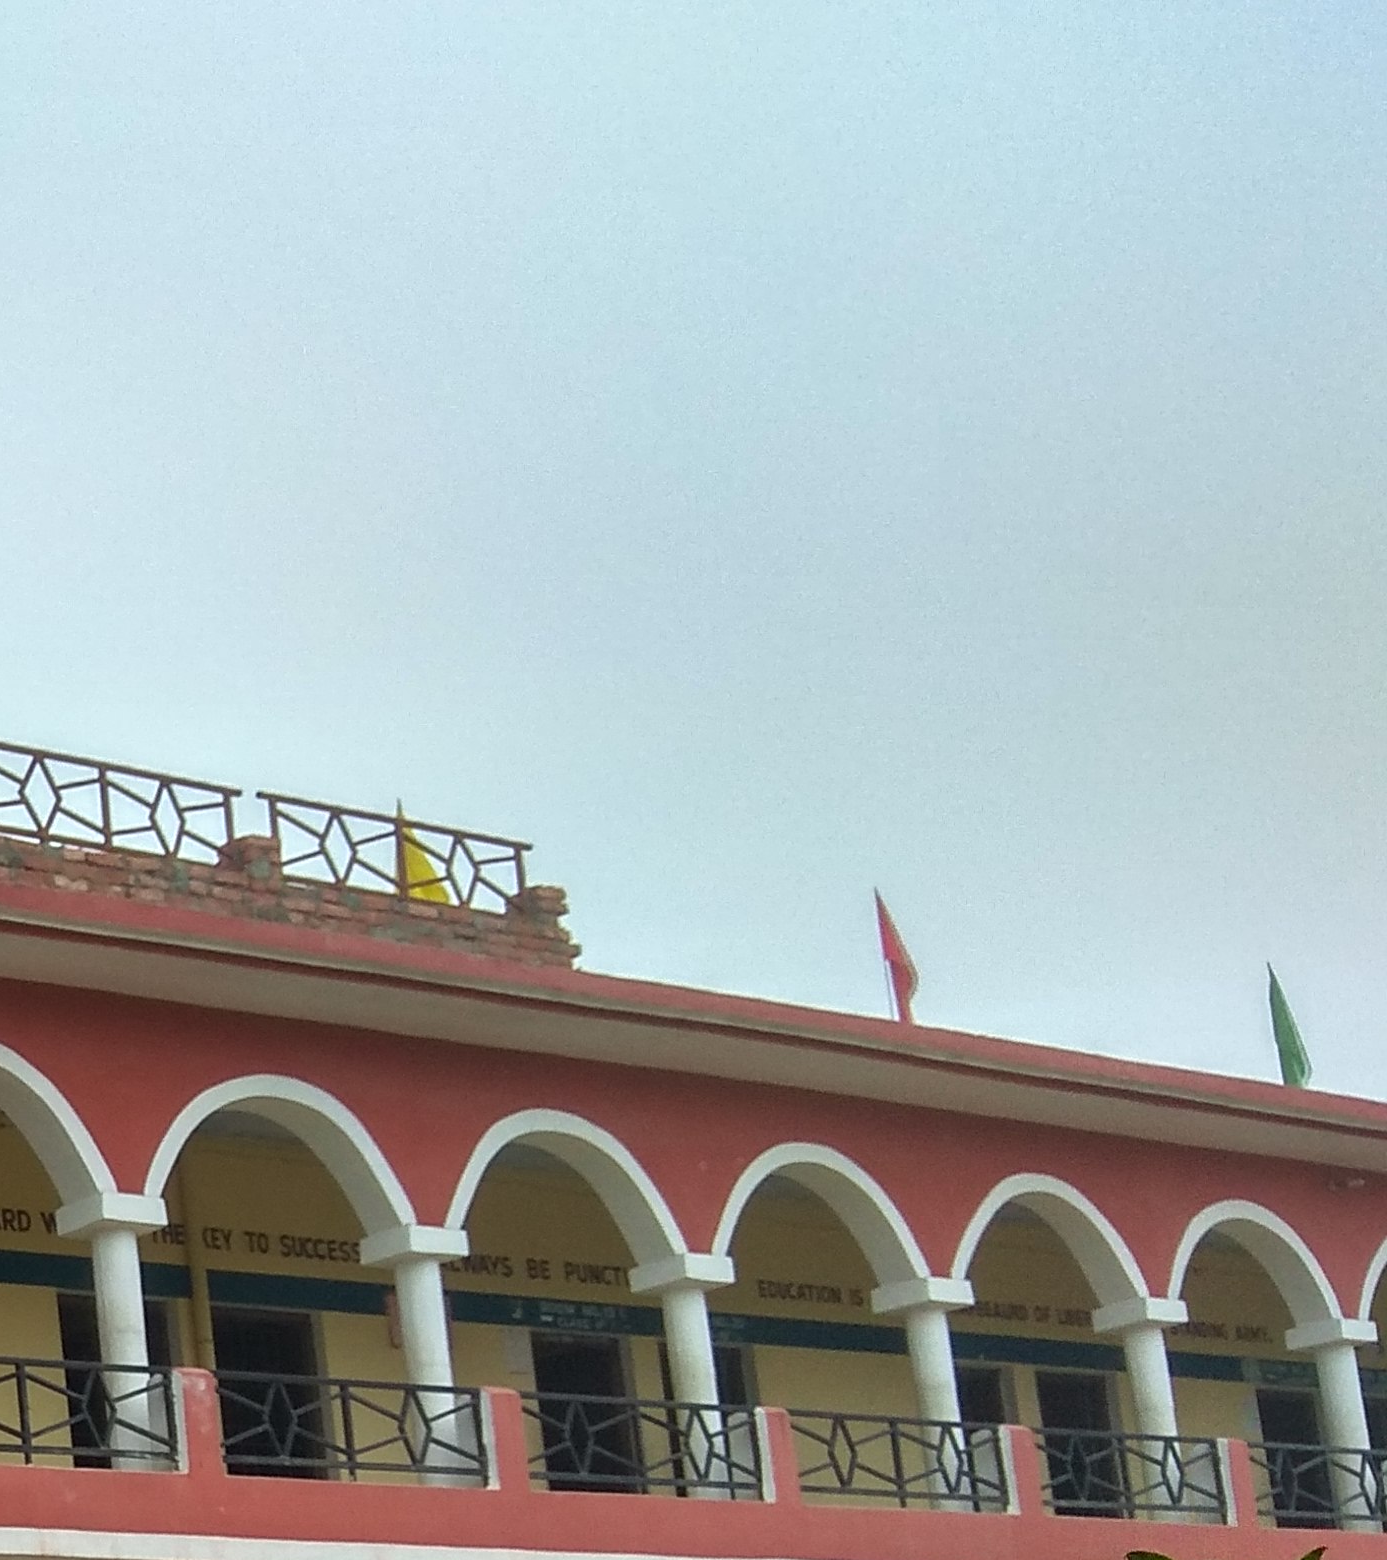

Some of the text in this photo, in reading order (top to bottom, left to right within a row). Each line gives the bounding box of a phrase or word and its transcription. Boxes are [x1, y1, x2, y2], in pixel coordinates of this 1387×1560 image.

[243, 1231, 269, 1254] TO
[526, 1258, 551, 1280] BE
[757, 1279, 843, 1304] EDUCATION
